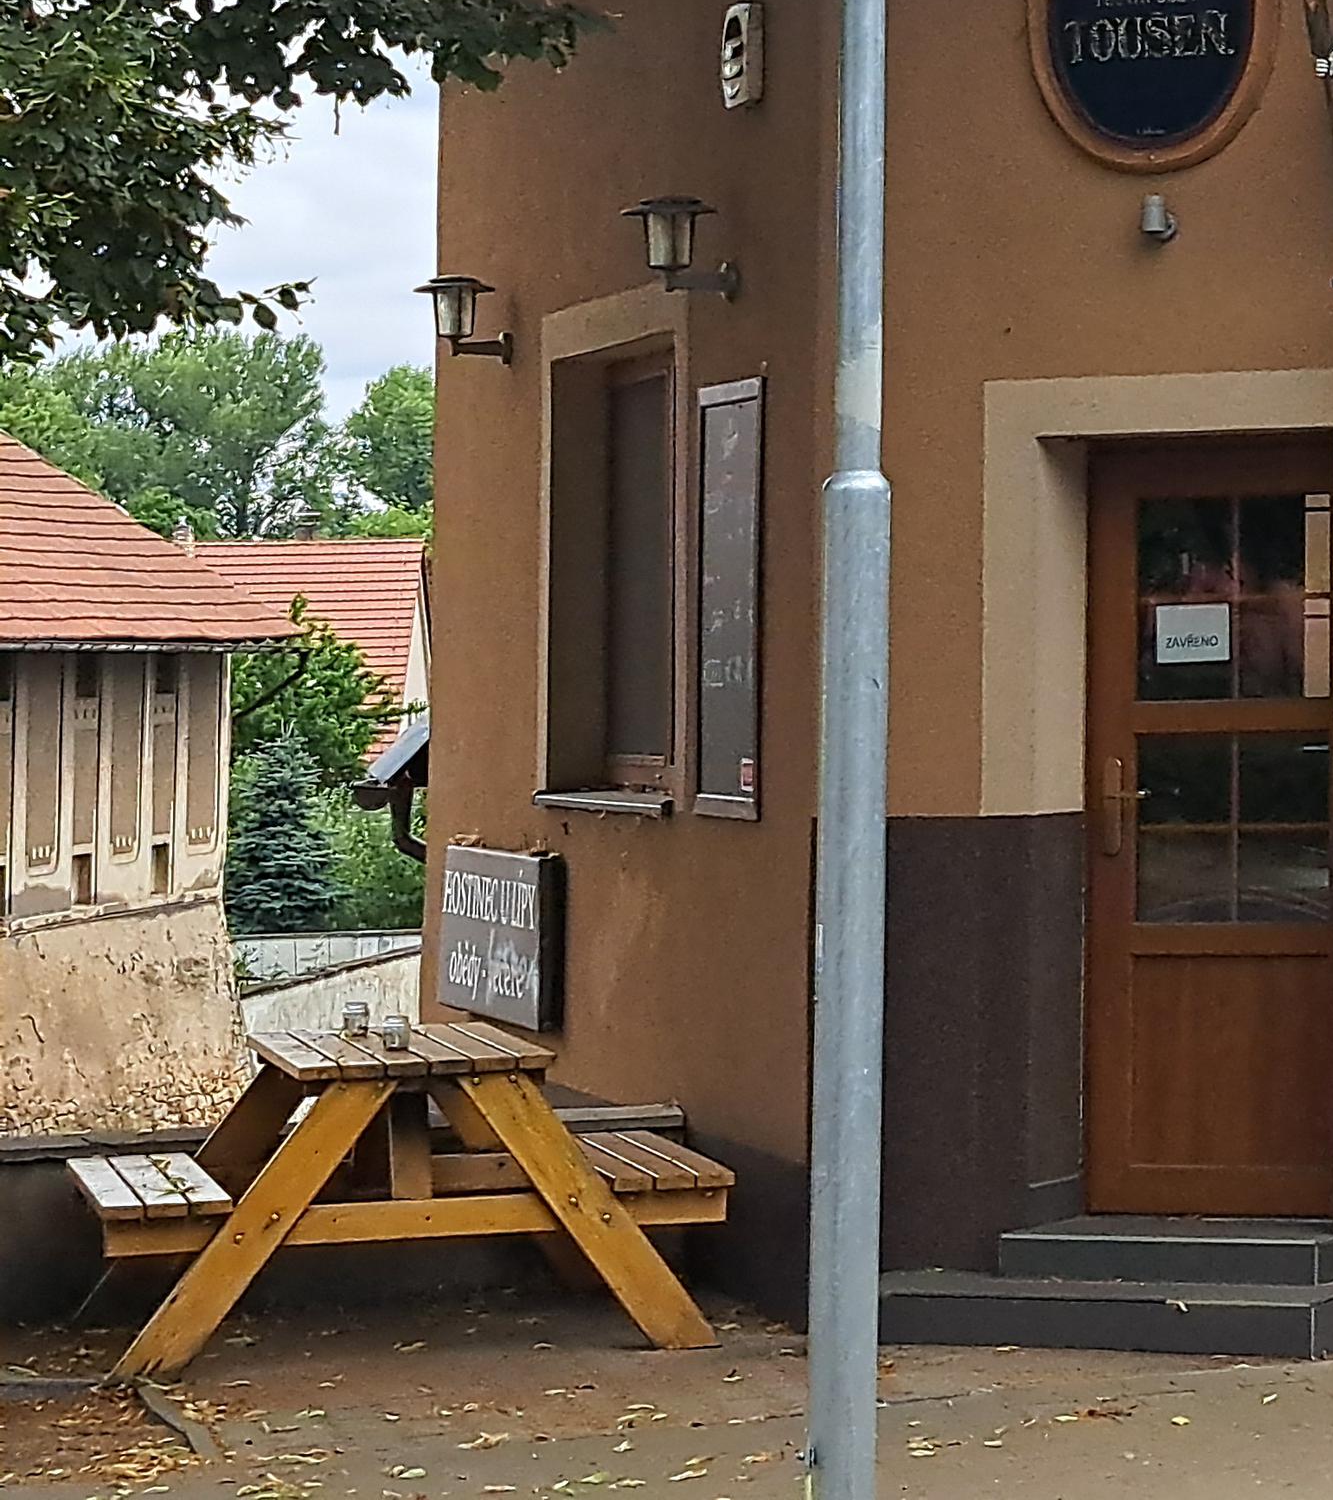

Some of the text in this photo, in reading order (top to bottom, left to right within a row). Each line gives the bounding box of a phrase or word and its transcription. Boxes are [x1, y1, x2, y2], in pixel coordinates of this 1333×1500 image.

[1165, 633, 1219, 649] ZAVŘENO
[442, 868, 536, 929] HOSTINEC U LÍPY
[449, 940, 481, 1000] obědy
